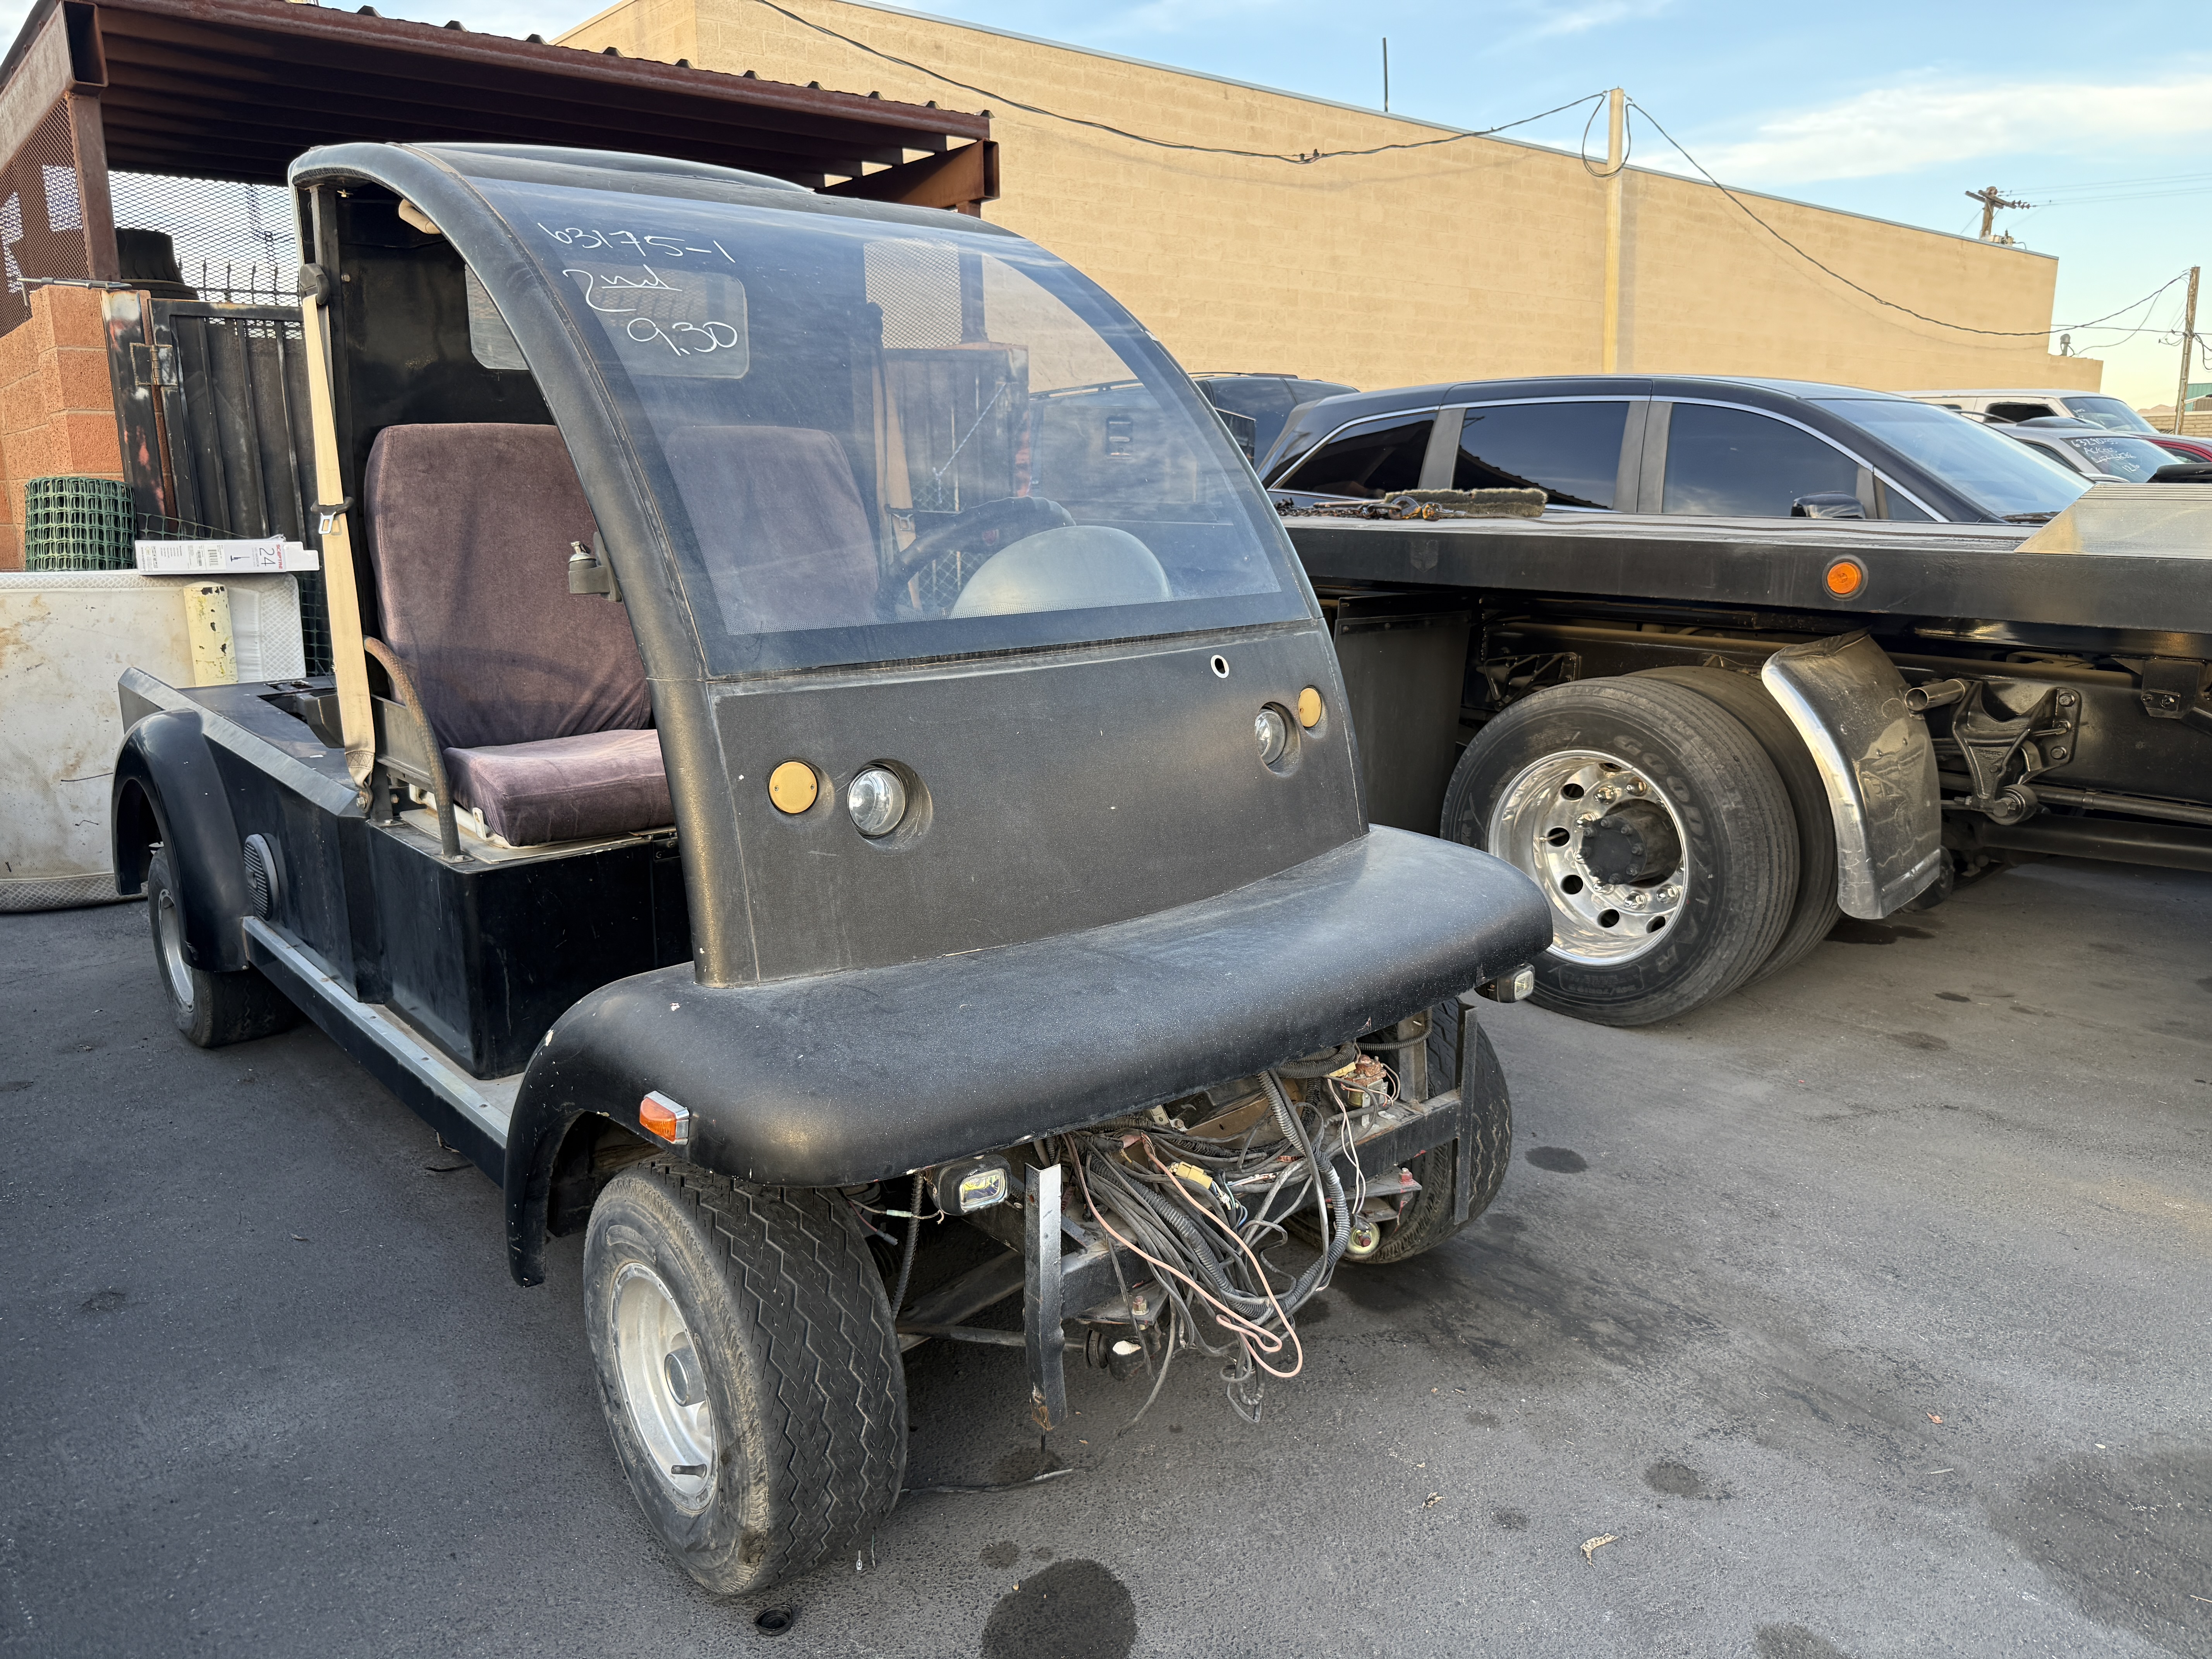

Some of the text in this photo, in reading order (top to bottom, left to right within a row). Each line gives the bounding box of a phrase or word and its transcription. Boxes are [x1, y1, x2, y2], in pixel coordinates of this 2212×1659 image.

[538, 222, 735, 263] 63175-1
[562, 264, 683, 313] 2nd
[259, 548, 276, 567] 24
